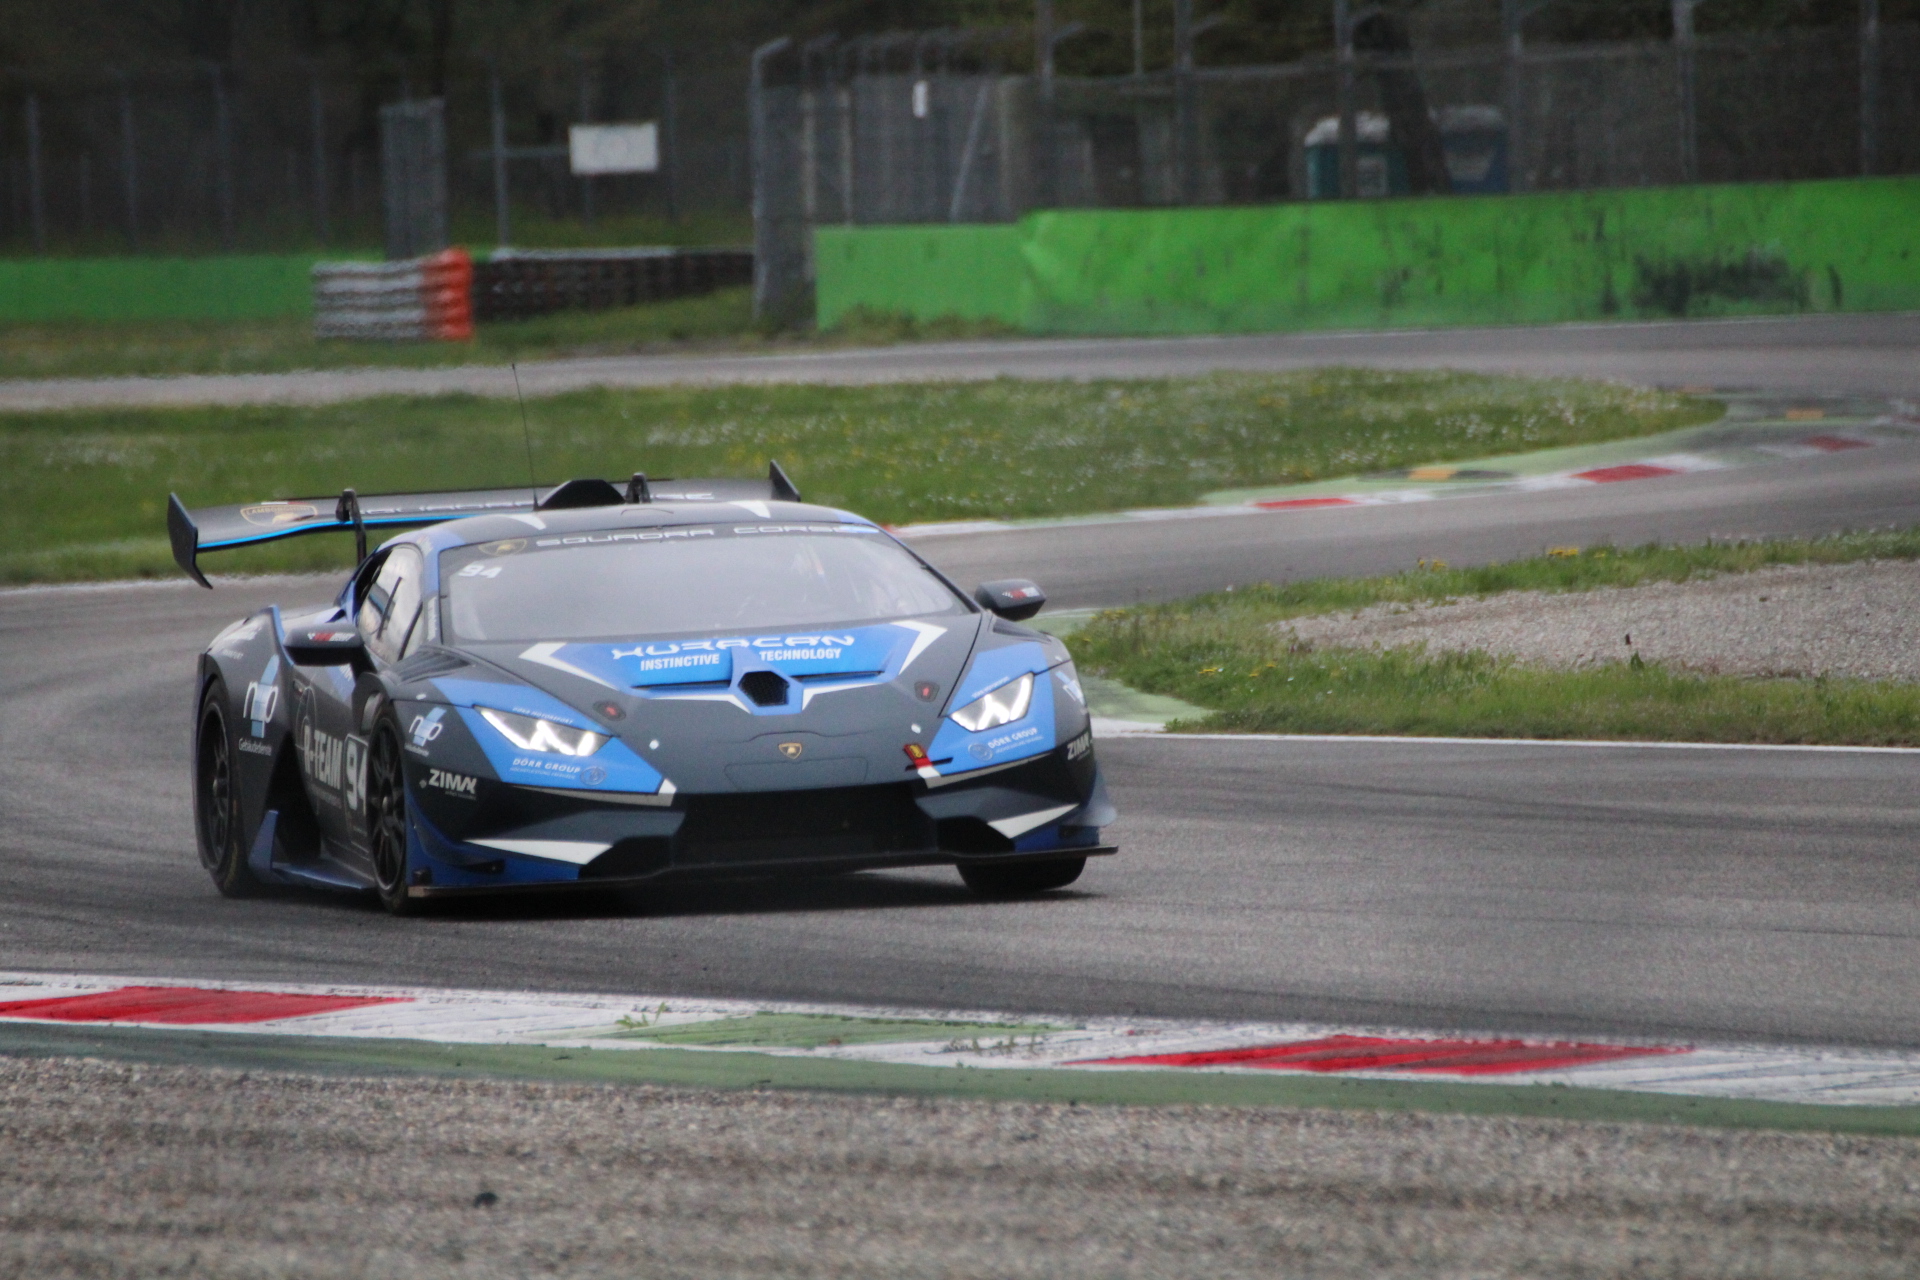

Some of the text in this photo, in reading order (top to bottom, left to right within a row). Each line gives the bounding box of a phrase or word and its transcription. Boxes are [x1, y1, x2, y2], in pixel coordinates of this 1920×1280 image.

[536, 529, 714, 546] SQUADRA
[458, 563, 502, 579] 94
[640, 653, 720, 671] INSTINCTIVE
[759, 648, 842, 661] TECHNOLOGY
[512, 757, 582, 774] DÖRR GROUP
